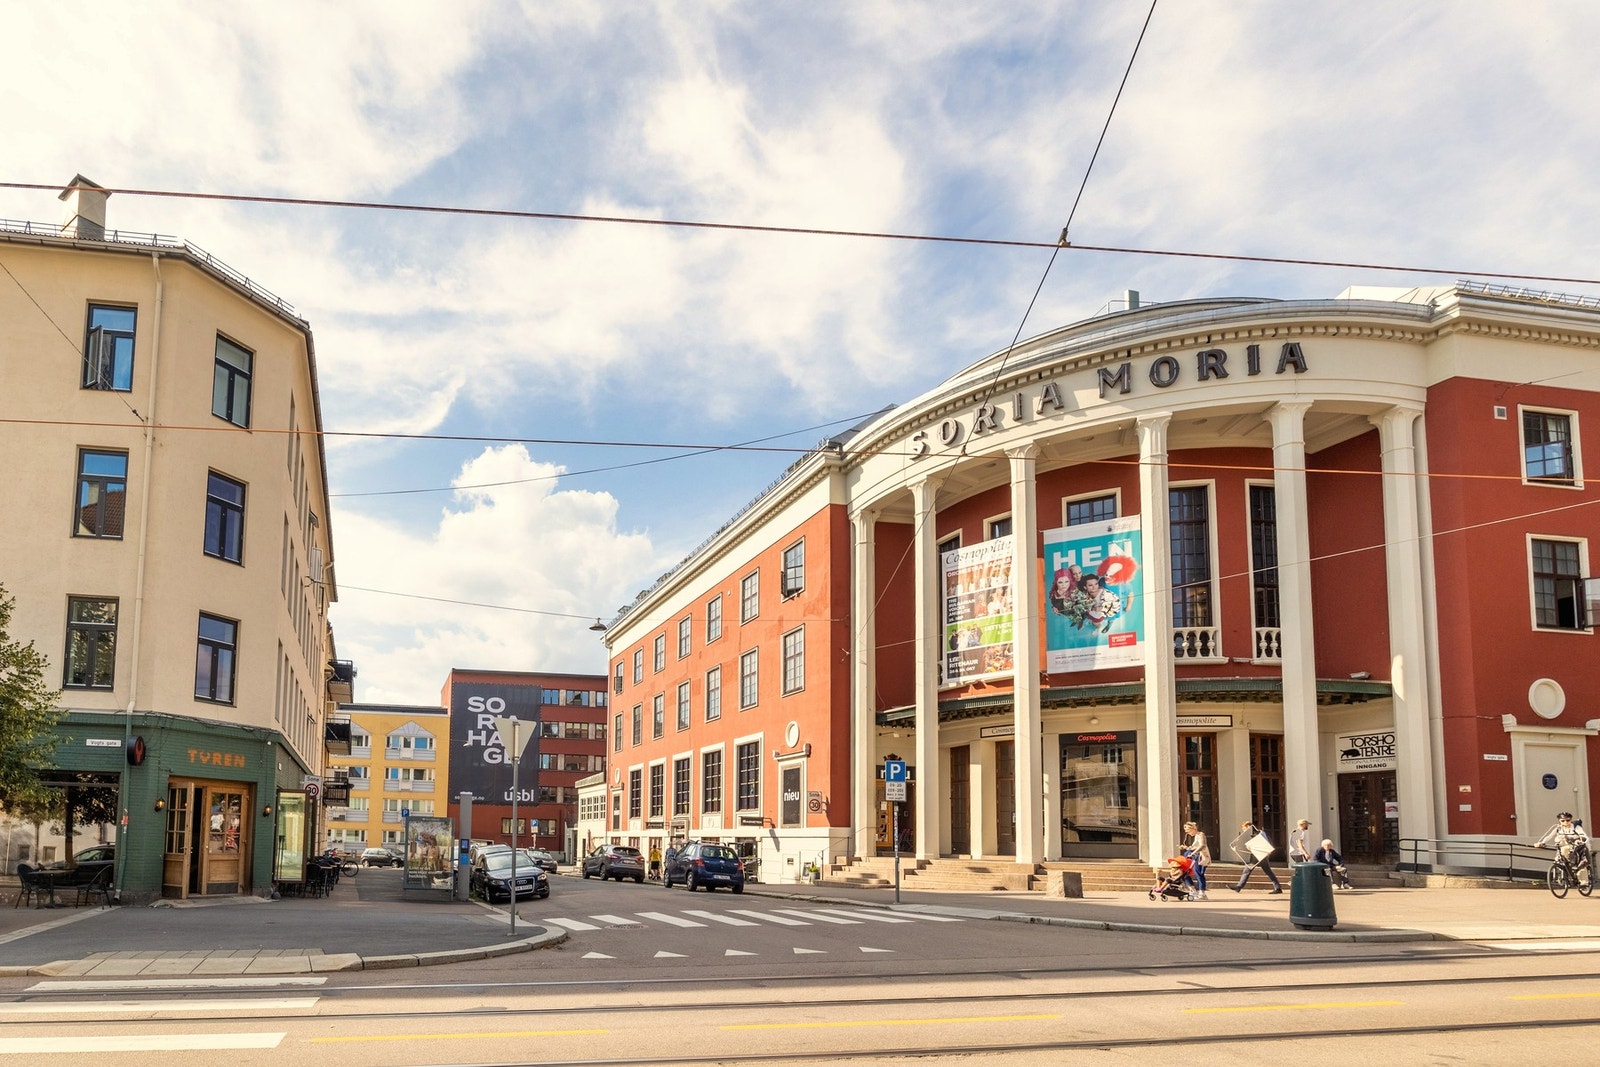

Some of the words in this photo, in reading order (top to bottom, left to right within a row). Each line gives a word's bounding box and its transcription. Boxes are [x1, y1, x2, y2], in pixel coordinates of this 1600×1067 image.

[910, 381, 1063, 460] SORIA
[1097, 342, 1309, 399] MORIA
[1053, 540, 1133, 571] HEN
[467, 696, 506, 713] SO
[467, 730, 505, 746] HA
[1077, 733, 1117, 742] Cosmopolite
[1349, 734, 1396, 748] TORSHO
[187, 749, 246, 768] TYREN
[1359, 744, 1396, 757] TEATRE
[890, 763, 901, 780] P
[783, 788, 800, 802] nieu
[811, 801, 819, 809] 30
